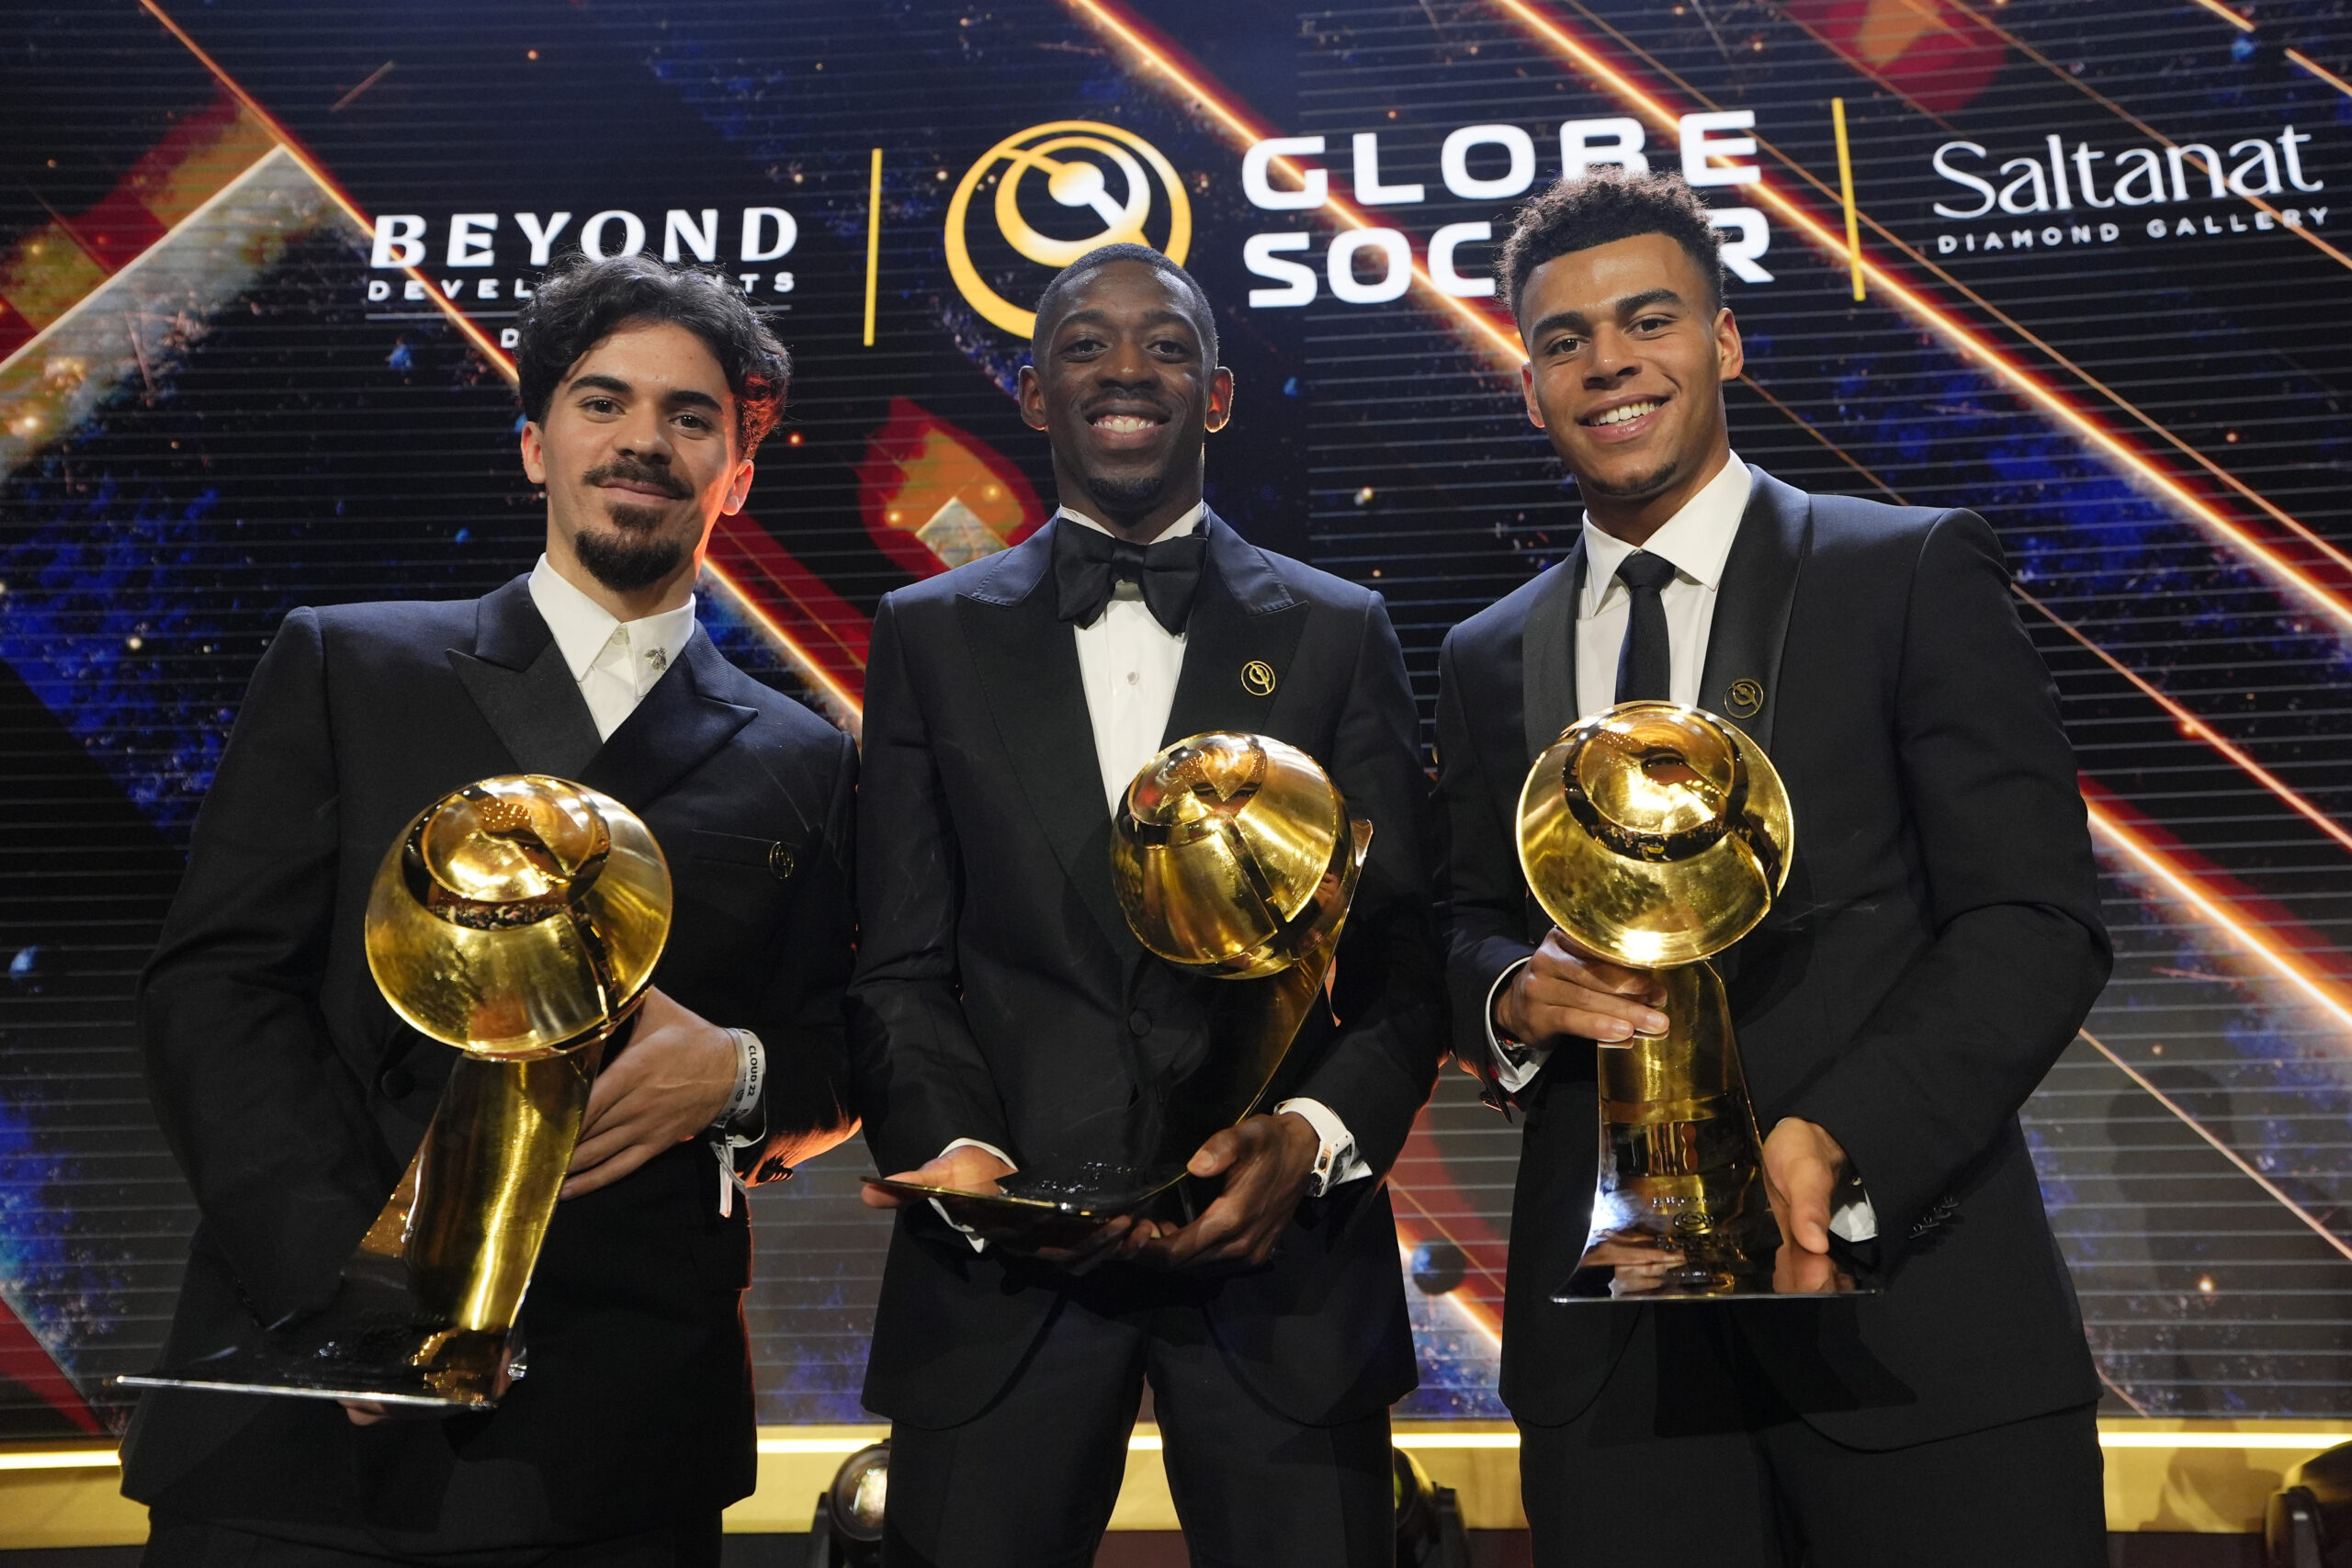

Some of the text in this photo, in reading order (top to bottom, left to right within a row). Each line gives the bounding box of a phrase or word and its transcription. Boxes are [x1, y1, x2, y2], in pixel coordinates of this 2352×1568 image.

[1242, 109, 1762, 210] GLOBE
[1932, 125, 2324, 219] Saltanat
[370, 208, 797, 268] BEYOND
[1243, 207, 1775, 308] SOCR
[1938, 207, 2328, 254] DIAMOND GALLERY
[368, 272, 795, 301] DEVELTS
[747, 1045, 758, 1097] CLOUD 22
